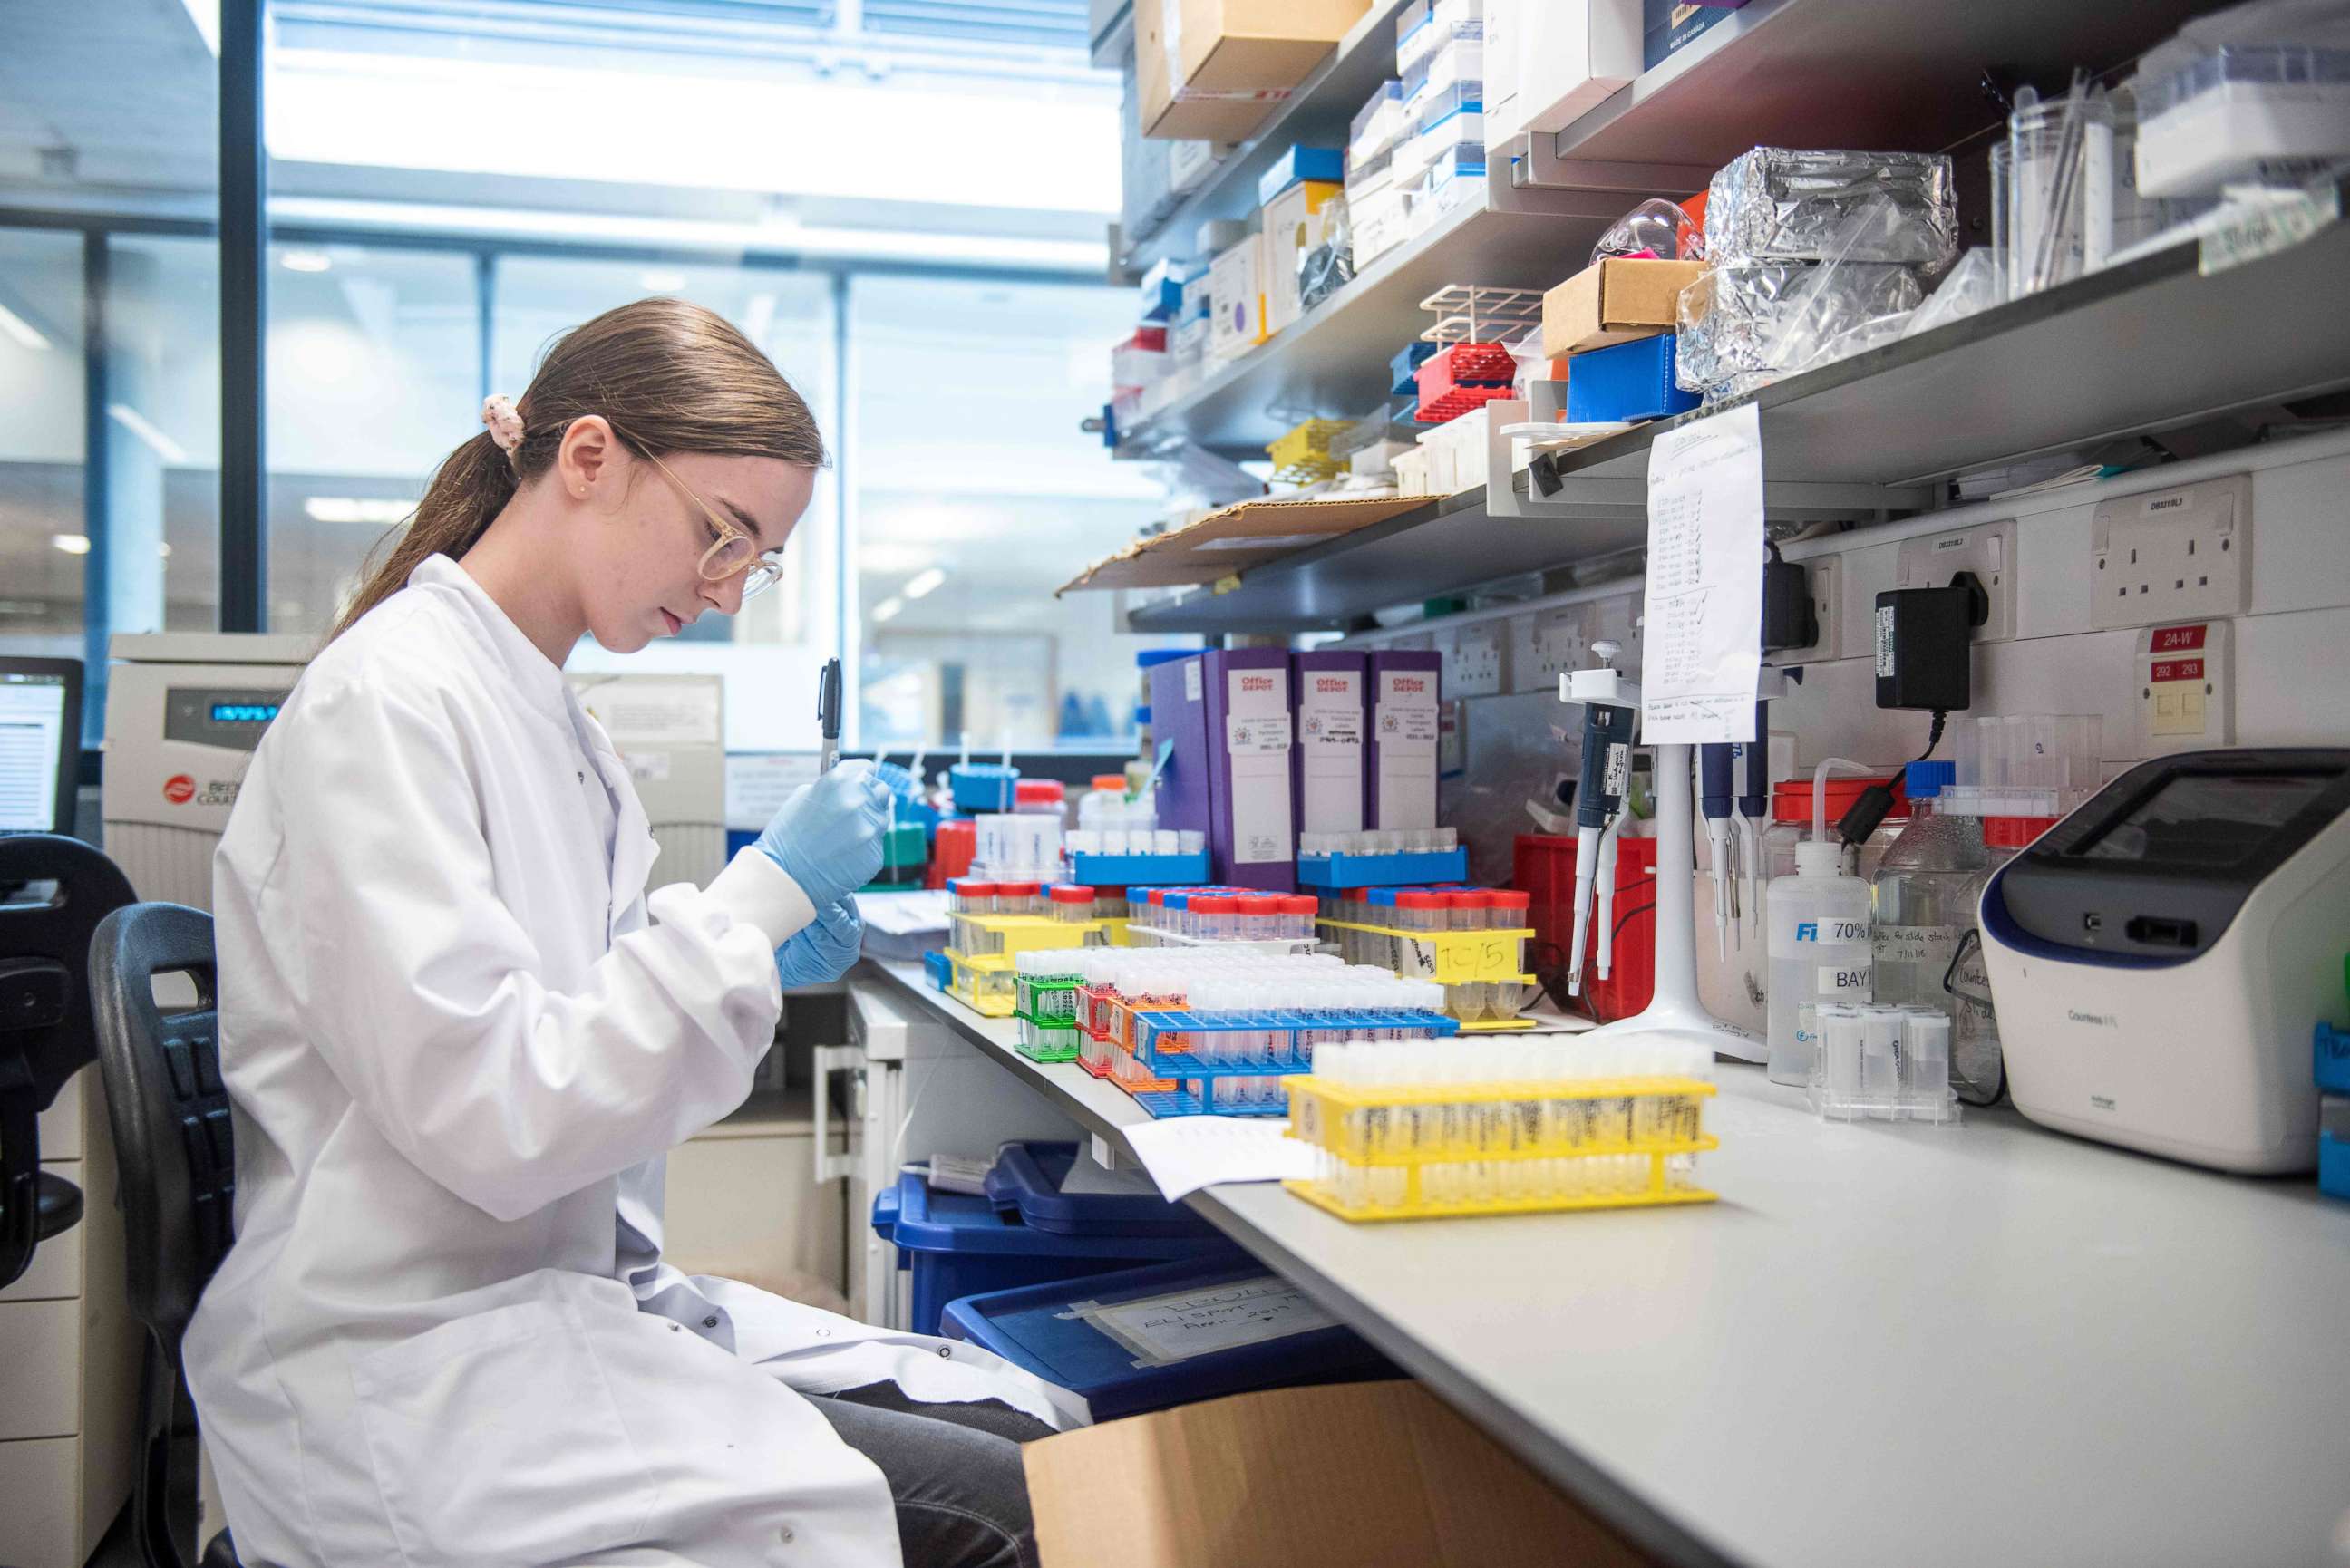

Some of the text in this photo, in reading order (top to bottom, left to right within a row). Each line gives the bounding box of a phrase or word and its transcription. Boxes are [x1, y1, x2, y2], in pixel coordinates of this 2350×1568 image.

[2163, 632, 2193, 646] 2A-W
[2155, 663, 2198, 678] 292 293
[1241, 676, 1274, 685] Office
[1316, 678, 1348, 686] Office
[1393, 678, 1424, 686] Office
[1834, 923, 1865, 939] 70%
[1836, 971, 1867, 987] BAY
